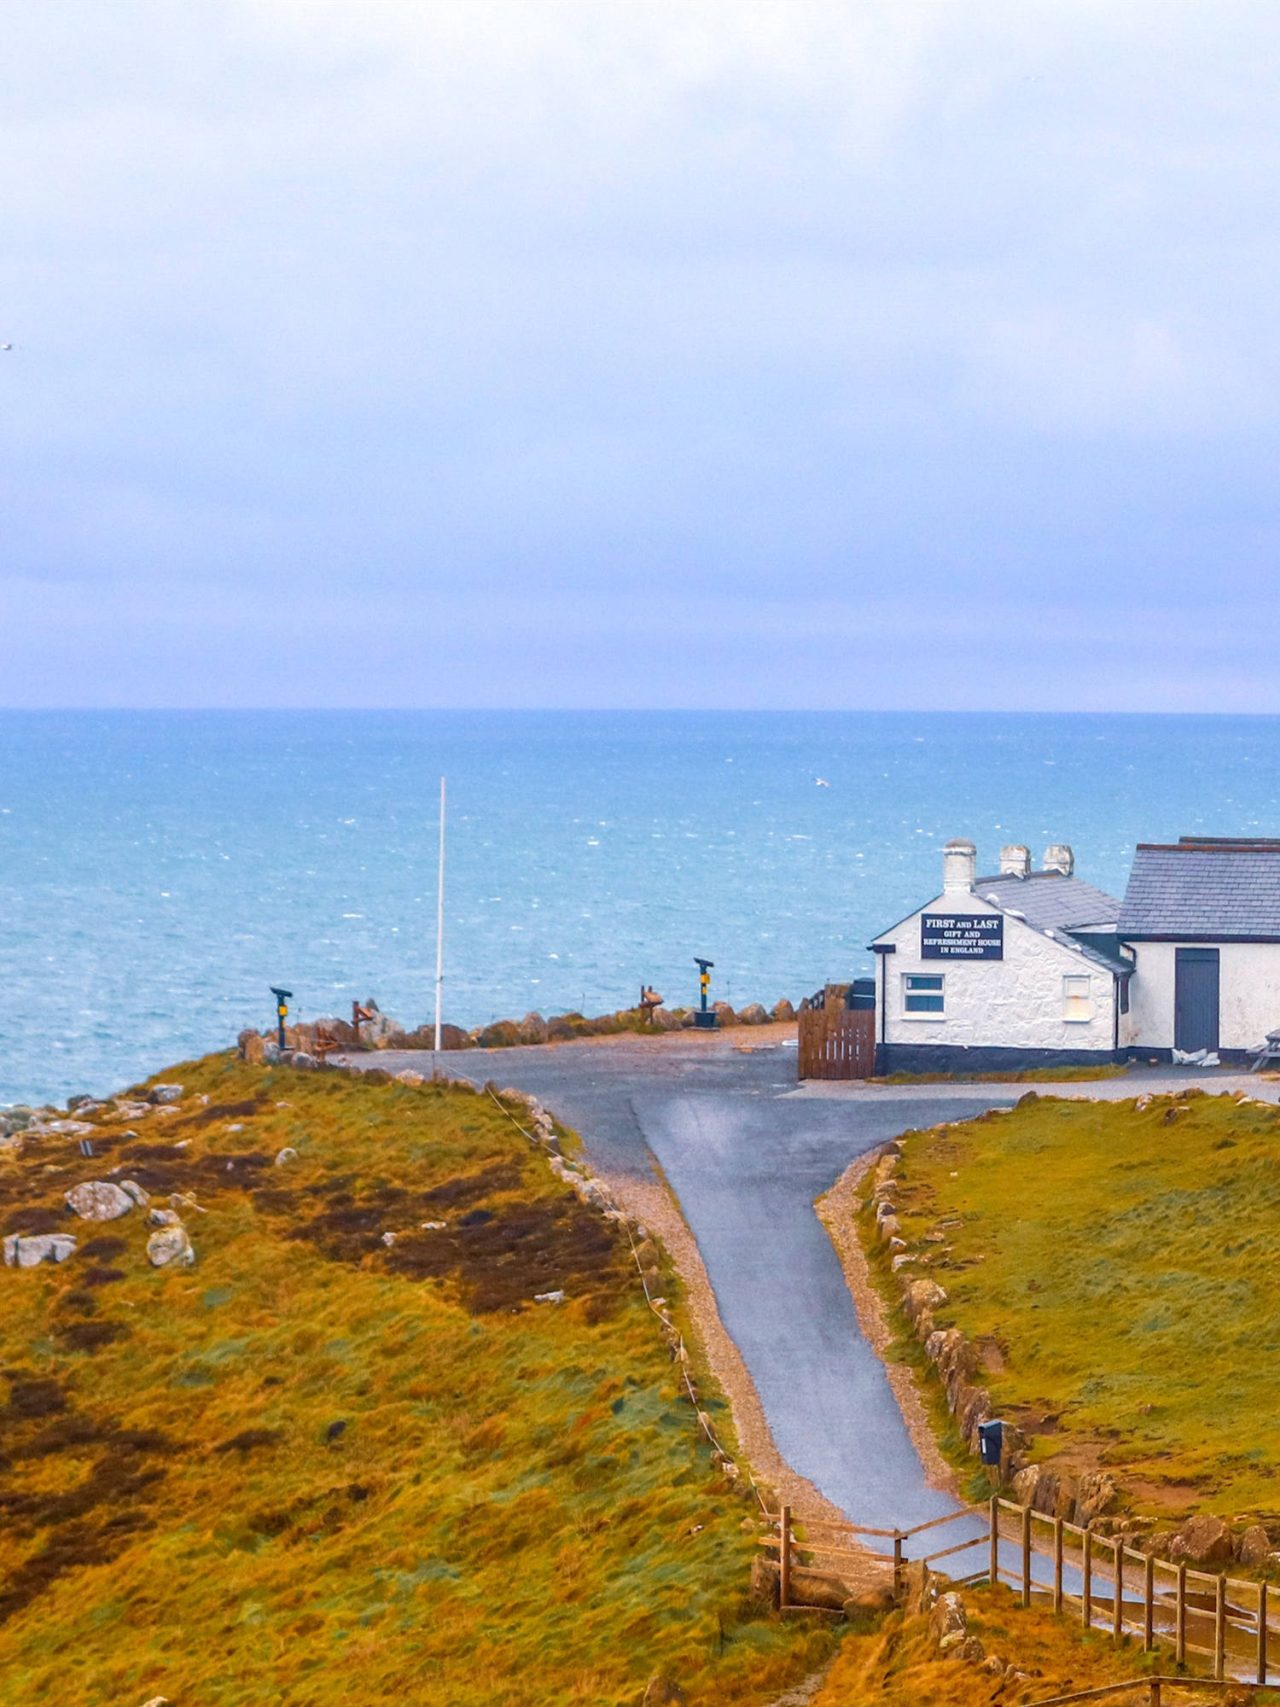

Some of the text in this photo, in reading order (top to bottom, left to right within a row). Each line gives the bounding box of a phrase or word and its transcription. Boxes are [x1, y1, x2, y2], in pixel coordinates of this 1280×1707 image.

[926, 919, 955, 928] FIRST
[973, 920, 999, 929] LAST
[923, 938, 976, 946] REFRESHMENT
